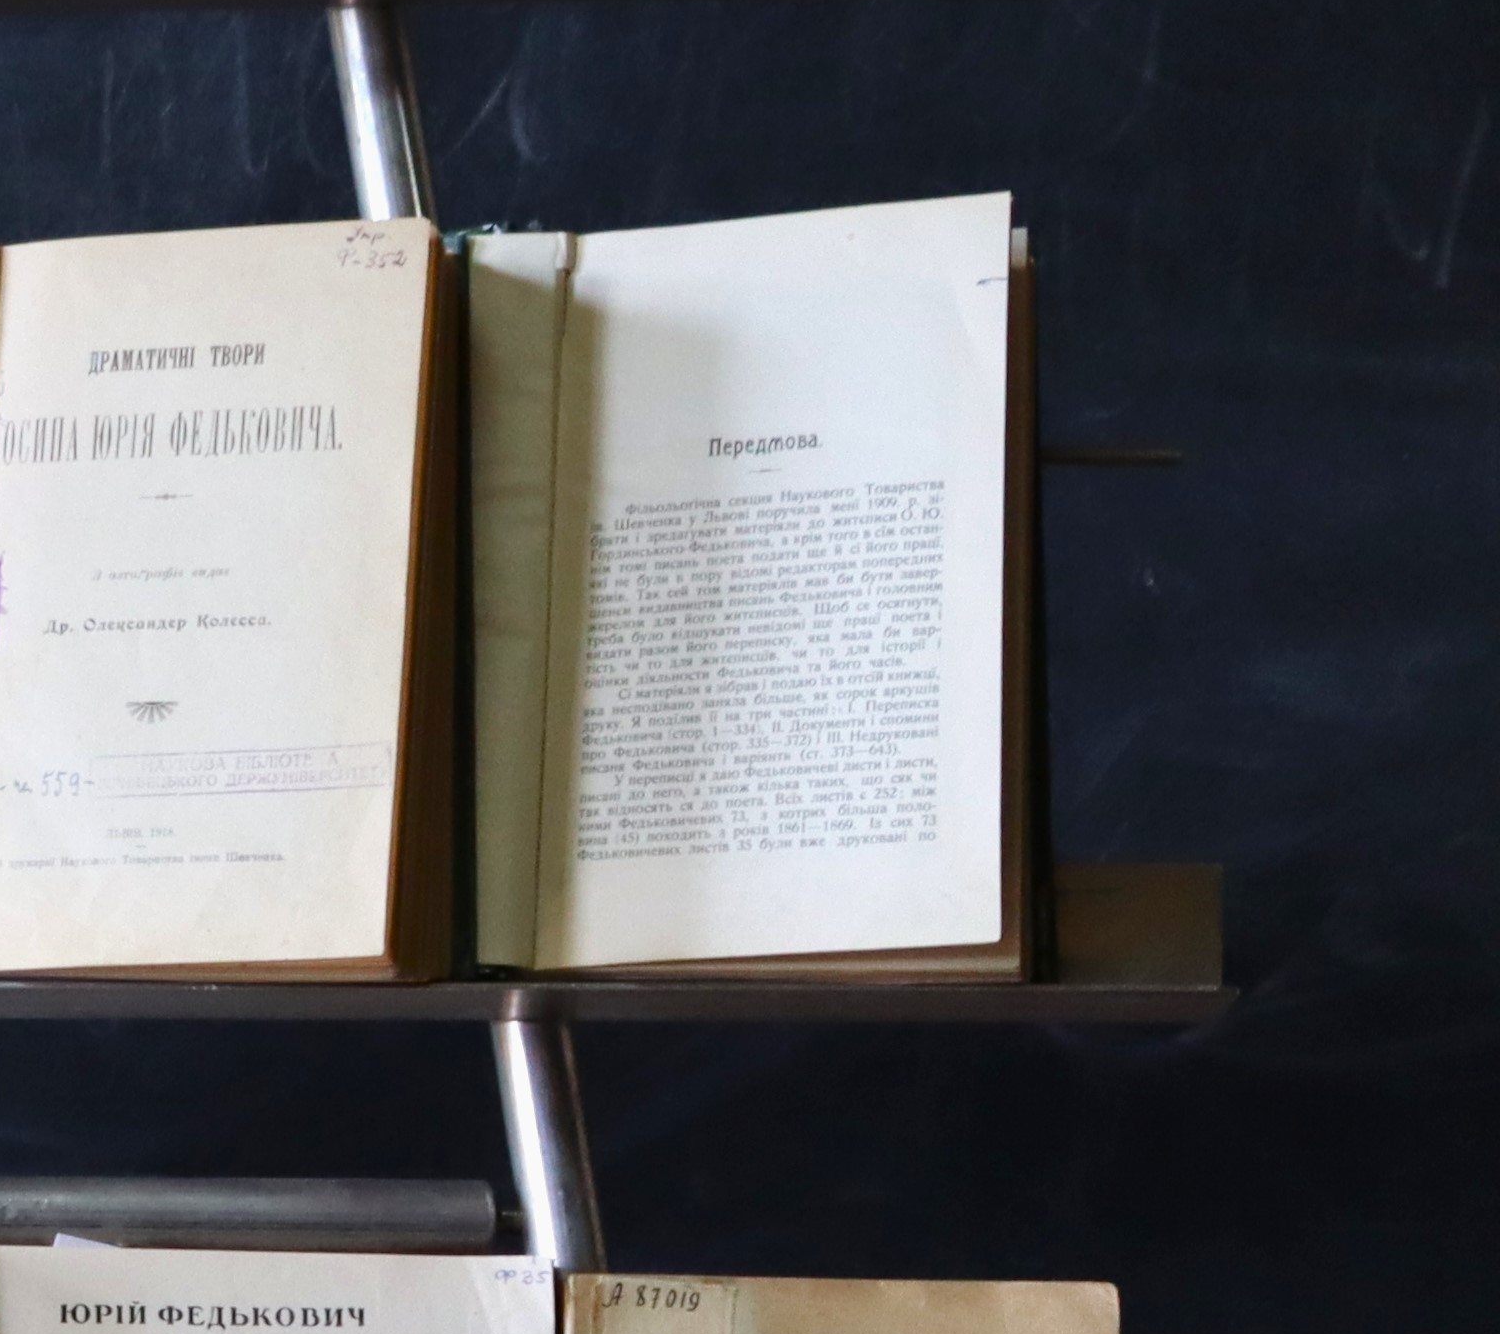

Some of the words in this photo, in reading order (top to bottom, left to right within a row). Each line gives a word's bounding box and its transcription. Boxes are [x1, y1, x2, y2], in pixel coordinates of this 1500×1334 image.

[88, 346, 196, 376] ДРАМАТИЧНІ
[210, 343, 266, 367] ТВОРИ
[3, 416, 78, 465] ОСИПА
[92, 412, 155, 461] ЮРІЯ
[169, 405, 343, 458] ФЕДЬКОВИЧА.
[59, 1299, 147, 1327] ЮРІЙ
[157, 1303, 367, 1331] ФЕДЬКОВИЧ
